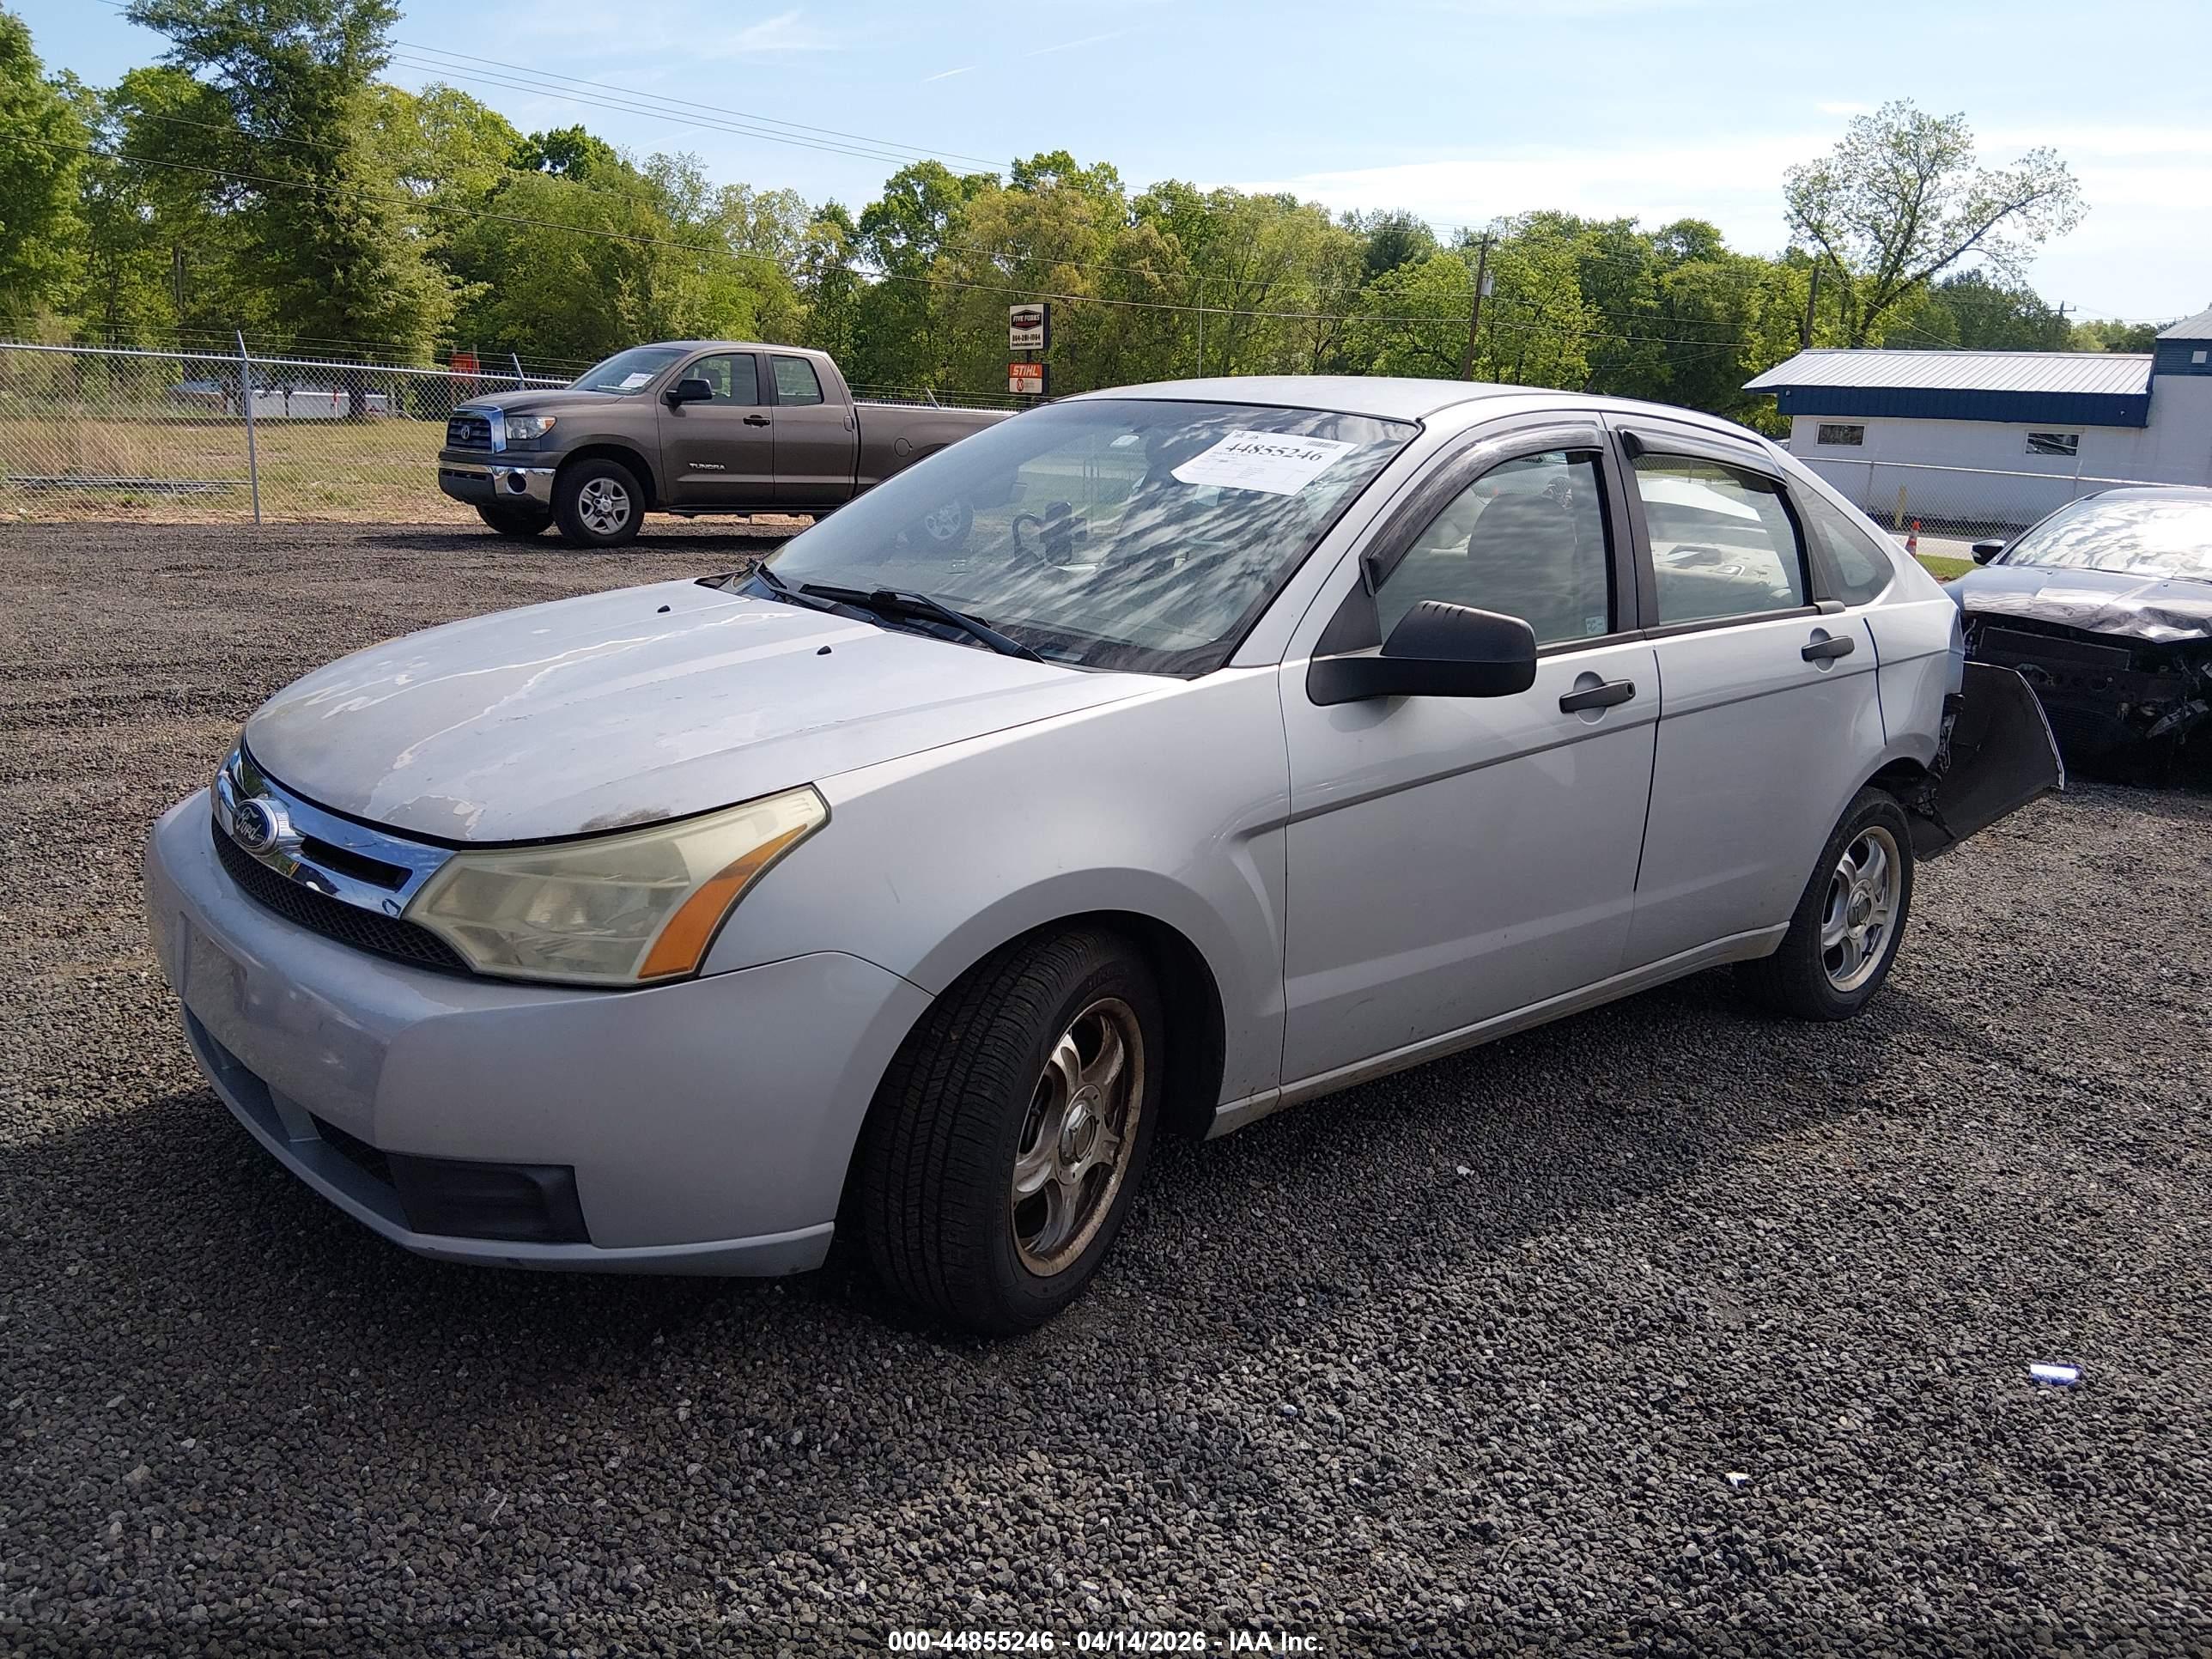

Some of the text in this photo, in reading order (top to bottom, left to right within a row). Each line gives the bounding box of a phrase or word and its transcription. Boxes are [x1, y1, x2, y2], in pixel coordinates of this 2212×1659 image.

[1012, 365, 1038, 376] STIHL
[1225, 442, 1325, 461] 44855246
[235, 806, 264, 841] Ford
